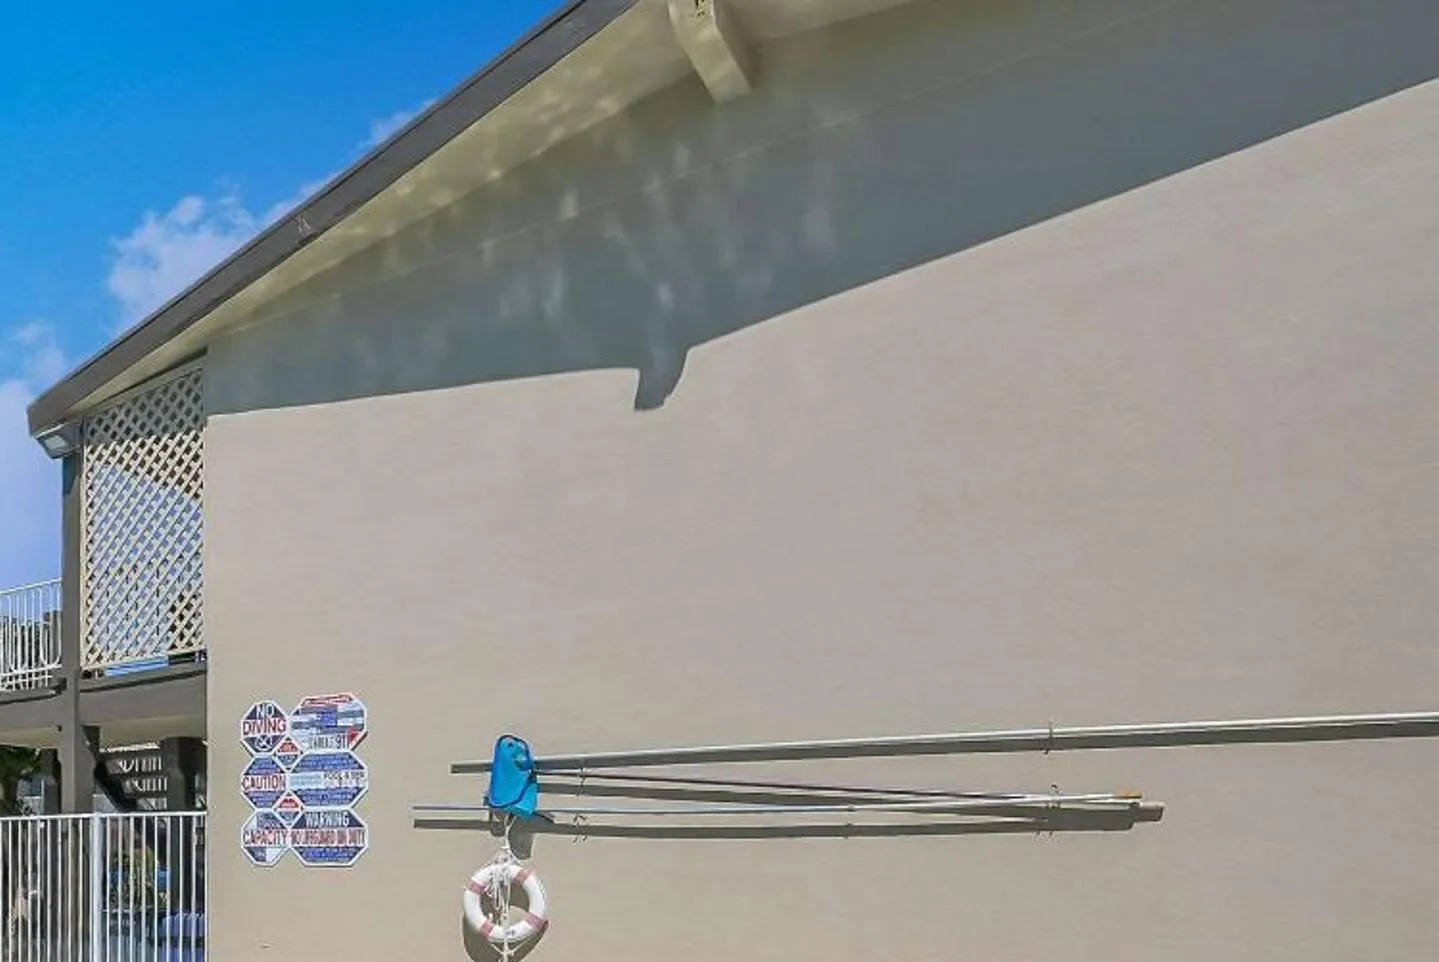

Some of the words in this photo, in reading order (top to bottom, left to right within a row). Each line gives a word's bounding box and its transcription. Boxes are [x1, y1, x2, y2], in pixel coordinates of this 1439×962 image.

[256, 703, 275, 719] NO
[243, 719, 286, 735] DIVING
[242, 775, 286, 791] CAUTION
[305, 811, 350, 827] WARNING
[243, 830, 288, 845] CAPACITY
